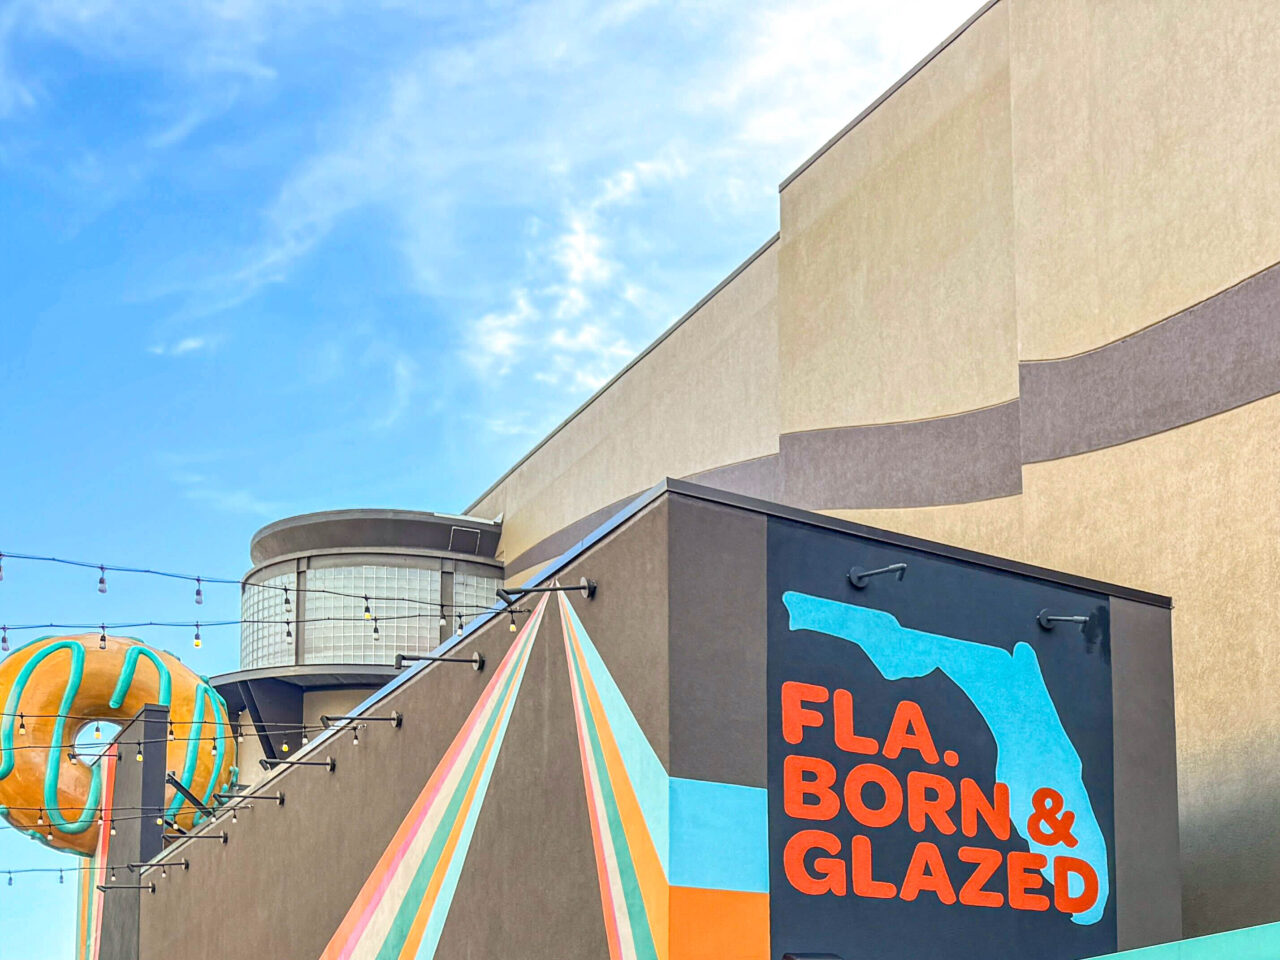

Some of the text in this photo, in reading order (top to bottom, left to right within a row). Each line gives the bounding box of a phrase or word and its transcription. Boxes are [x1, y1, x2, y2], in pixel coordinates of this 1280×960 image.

[781, 681, 959, 767] FLA.
[783, 755, 1079, 848] BORN &
[783, 829, 1099, 914] GLAZED
